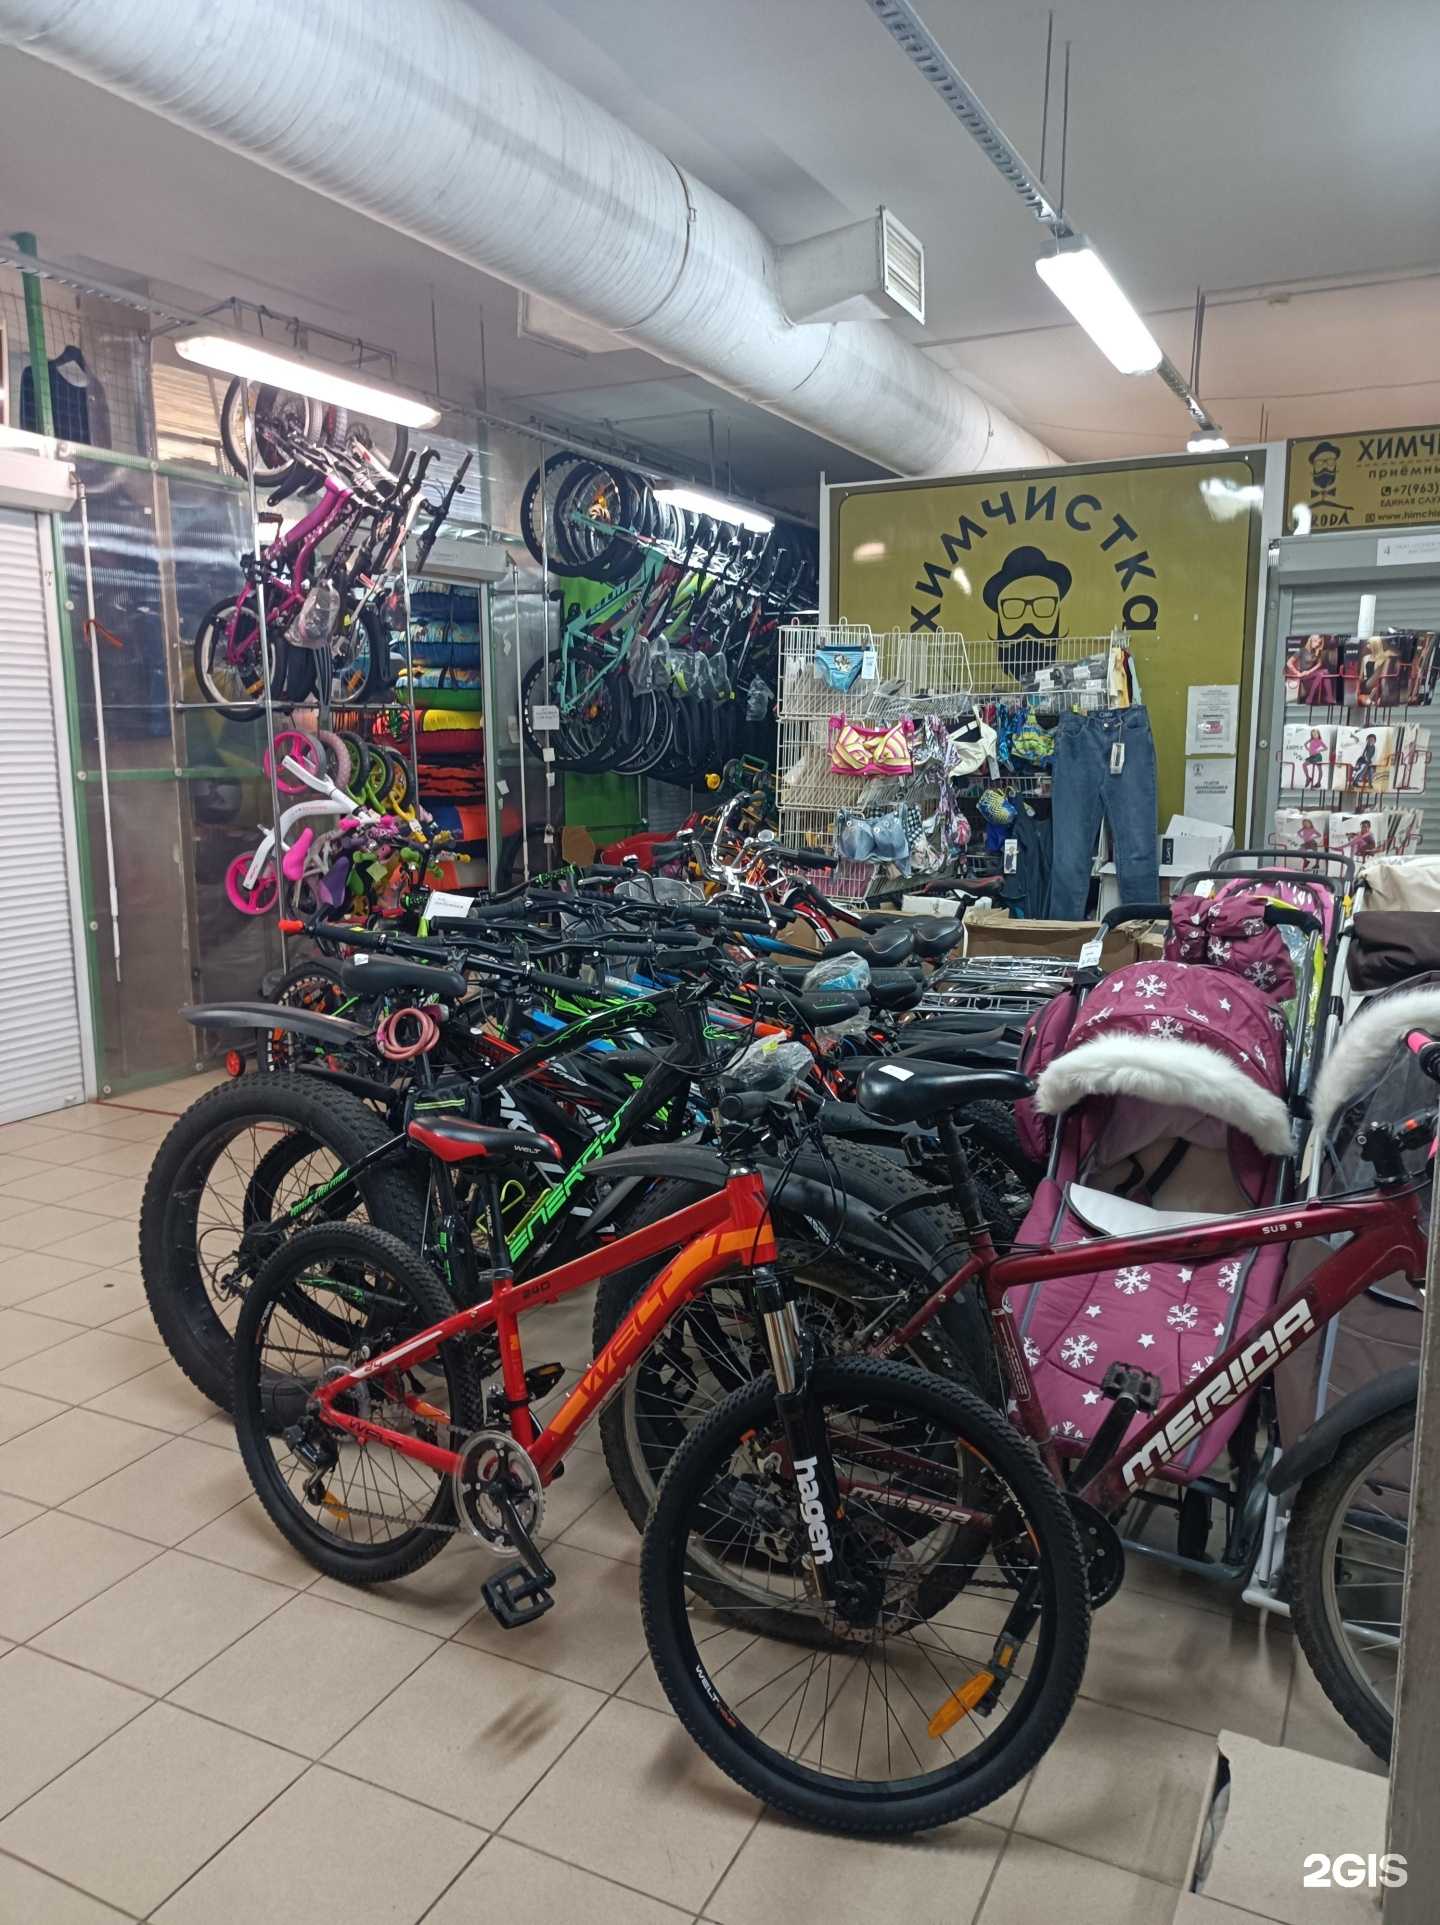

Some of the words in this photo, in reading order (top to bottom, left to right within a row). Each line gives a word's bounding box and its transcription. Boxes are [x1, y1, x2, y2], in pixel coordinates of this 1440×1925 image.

[1357, 432, 1440, 462] ХИМЧ
[513, 1144, 542, 1154] WELT
[1121, 1297, 1316, 1493] MERIDA
[793, 1456, 835, 1566] hagen
[849, 1486, 973, 1524] MERIDA
[693, 1662, 720, 1708] WELT
